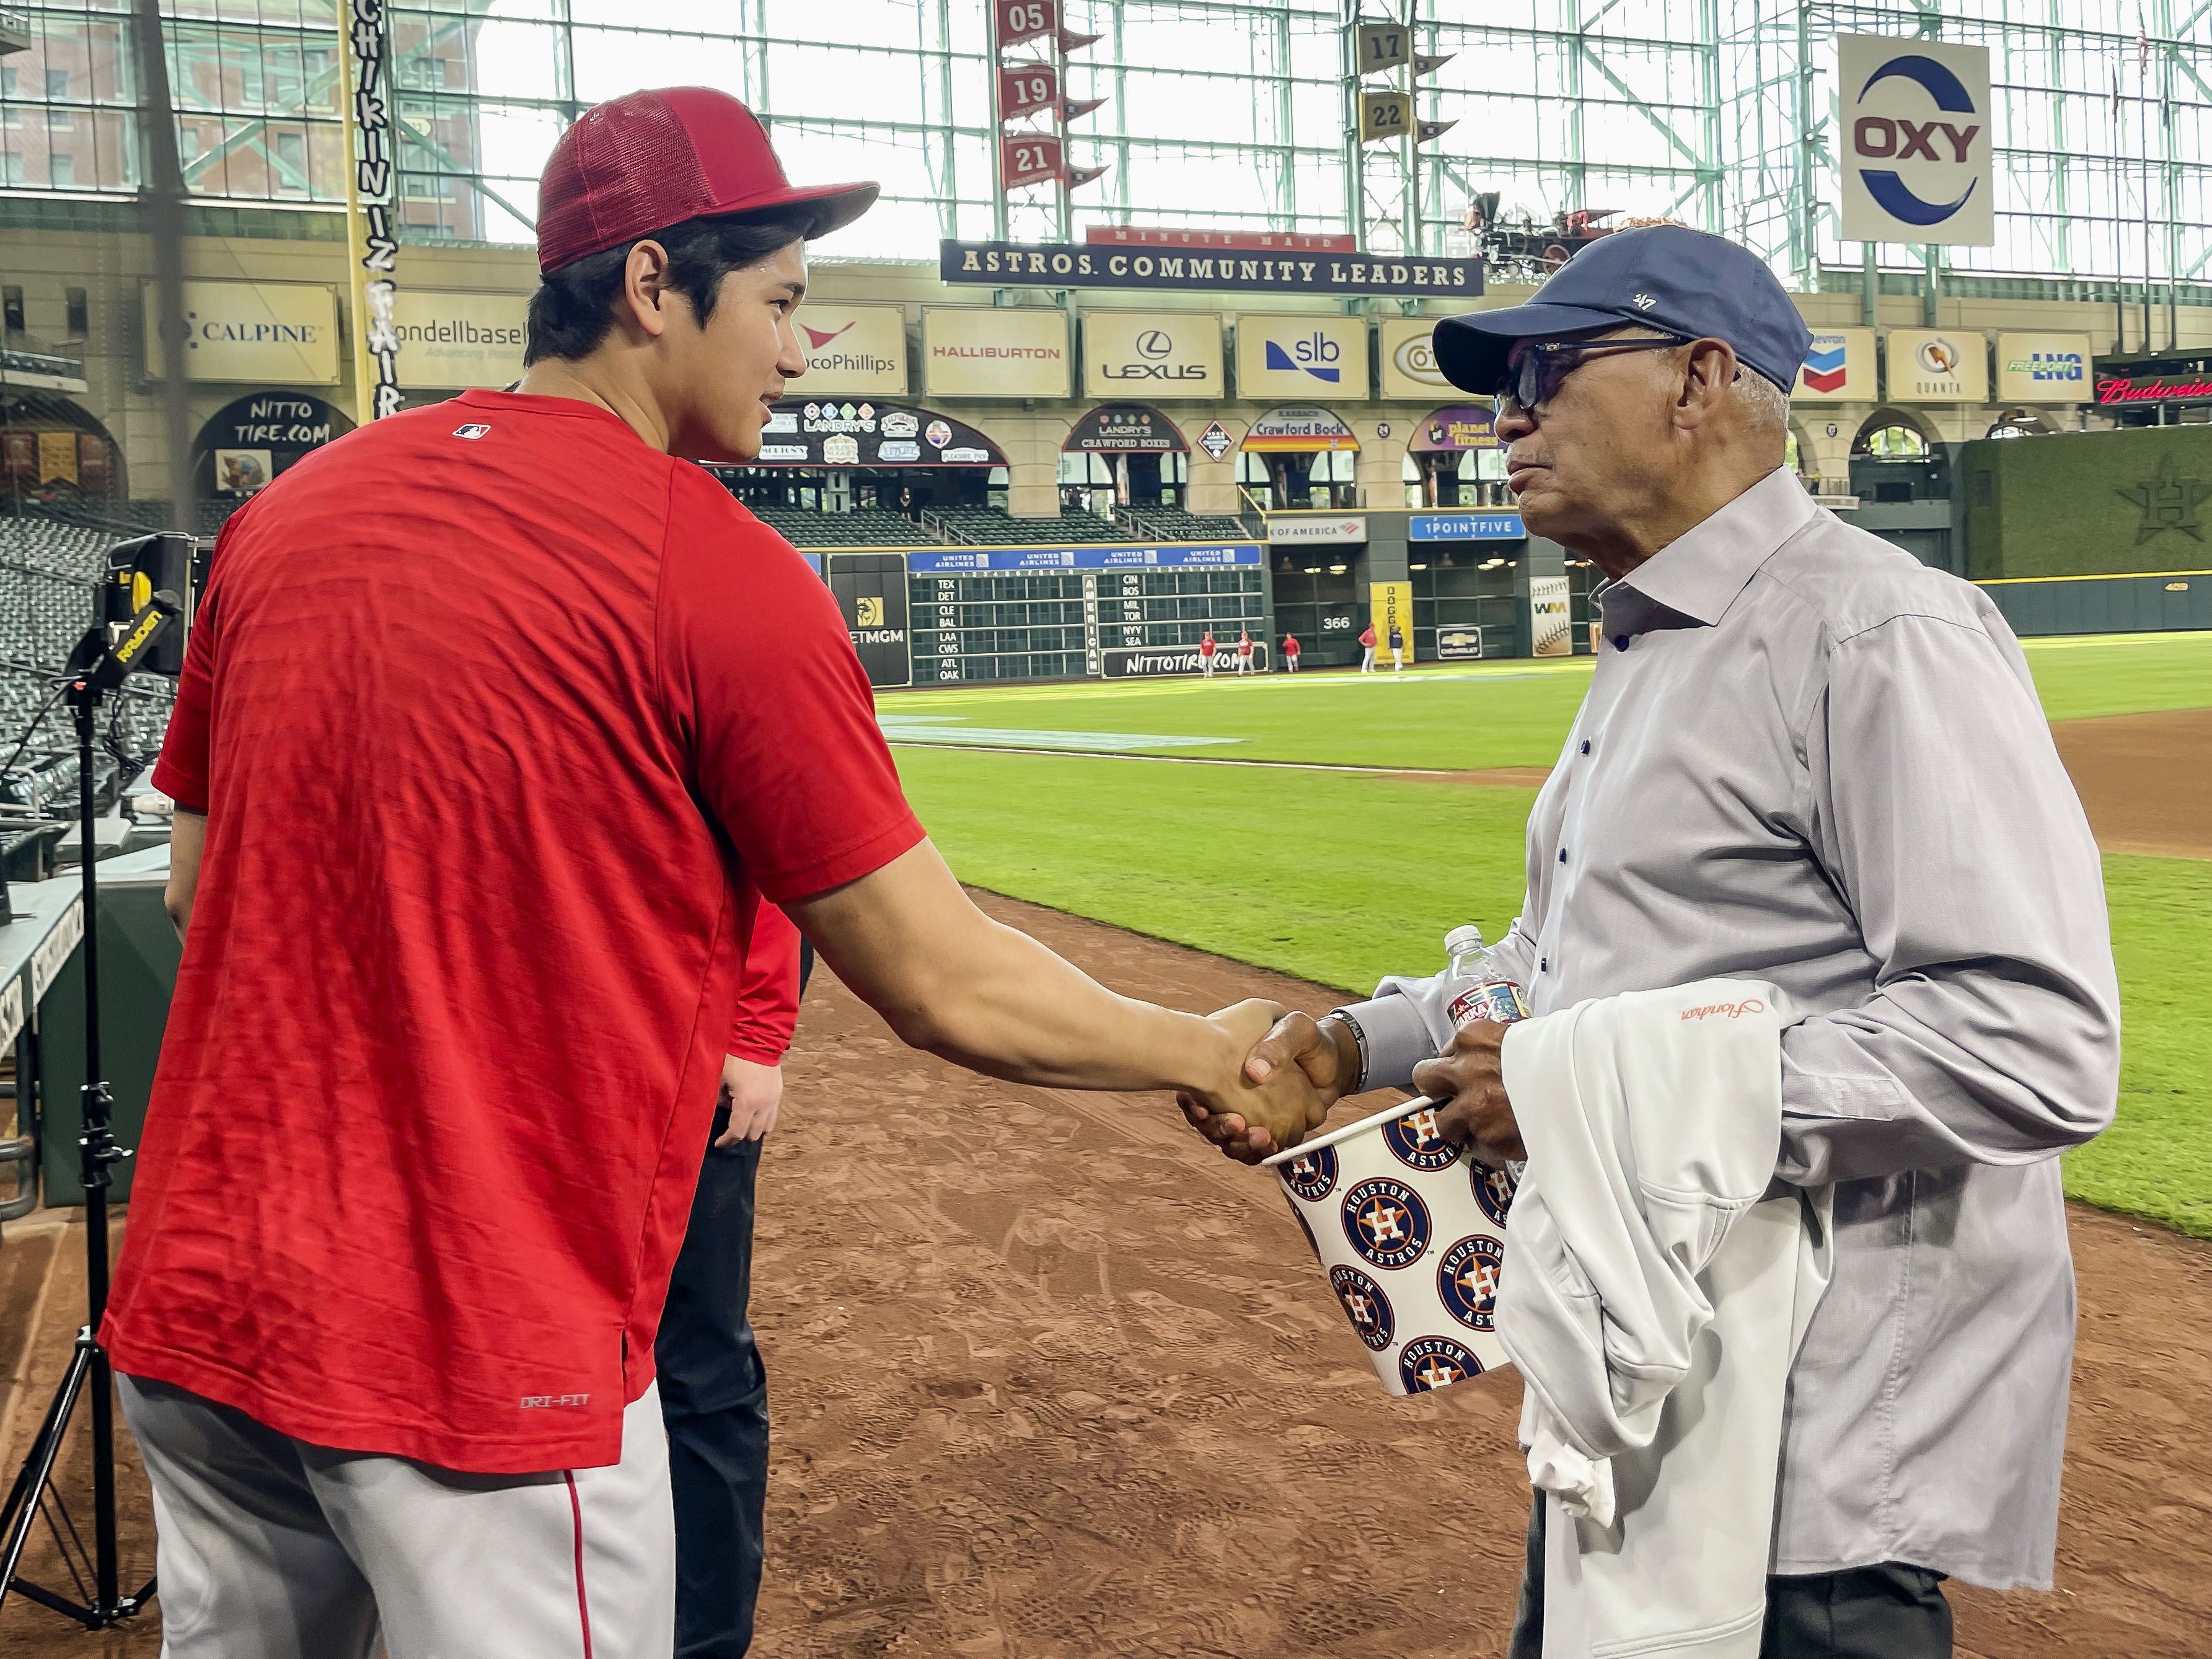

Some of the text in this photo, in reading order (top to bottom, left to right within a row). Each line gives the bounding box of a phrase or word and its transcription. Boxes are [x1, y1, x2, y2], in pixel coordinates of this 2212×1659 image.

[1009, 4, 1044, 32] 05
[1371, 35, 1399, 59] 17
[1014, 78, 1047, 104] 19
[1373, 105, 1401, 126] 22
[1854, 117, 1980, 162] OXY
[1016, 146, 1047, 172] 21
[1116, 231, 1332, 248] MINUTE MAID
[1109, 256, 1316, 282] COMMUNITY
[1331, 262, 1467, 286] LEADERS
[203, 321, 317, 343] CALPINE
[933, 346, 1060, 359] HALLIBURTON
[1296, 332, 1339, 362] slb
[1103, 364, 1207, 380] LEXUS
[2032, 353, 2082, 380] LNG
[1916, 382, 1961, 394] QUANTA
[250, 397, 312, 418] NITTO
[234, 422, 330, 443] TIRE.COM
[804, 419, 876, 433] LANDRY'S
[1256, 423, 1344, 435] Crawford Bock
[1448, 421, 1490, 436] planet
[1081, 439, 1170, 447] CRAWFORD BOXES
[1455, 434, 1499, 446] fitness
[1277, 528, 1289, 536] OF
[1293, 527, 1338, 536] AMERICA
[1425, 521, 1512, 534] 1POINTFIVE
[937, 579, 955, 589] TEX
[1122, 575, 1138, 584] CIN
[938, 592, 955, 601] DET
[1122, 586, 1139, 596] BOS
[939, 606, 954, 615] CLE
[1124, 601, 1139, 609] MIL
[1534, 602, 1567, 614] WM
[939, 618, 956, 627] BAL
[1123, 612, 1141, 620] TOR
[1085, 579, 1098, 670] AMERICAN
[1123, 625, 1142, 635] NYY
[1323, 617, 1351, 630] 366
[850, 630, 904, 643] ETMGM
[940, 633, 957, 641] LAA
[1125, 637, 1142, 646] SEA
[938, 644, 958, 654] CWS
[941, 658, 957, 667] ATL
[940, 671, 959, 680] OAK
[1407, 1146, 1455, 1166] ASTRO
[1290, 1174, 1331, 1196] ASTROS
[1346, 1182, 1410, 1213] HOUSTON
[1365, 1238, 1422, 1265] ASTROS
[1443, 1240, 1502, 1275] HOUSTON
[1404, 1341, 1466, 1369] HOUSTON
[521, 1394, 590, 1409] DRI-FIT
